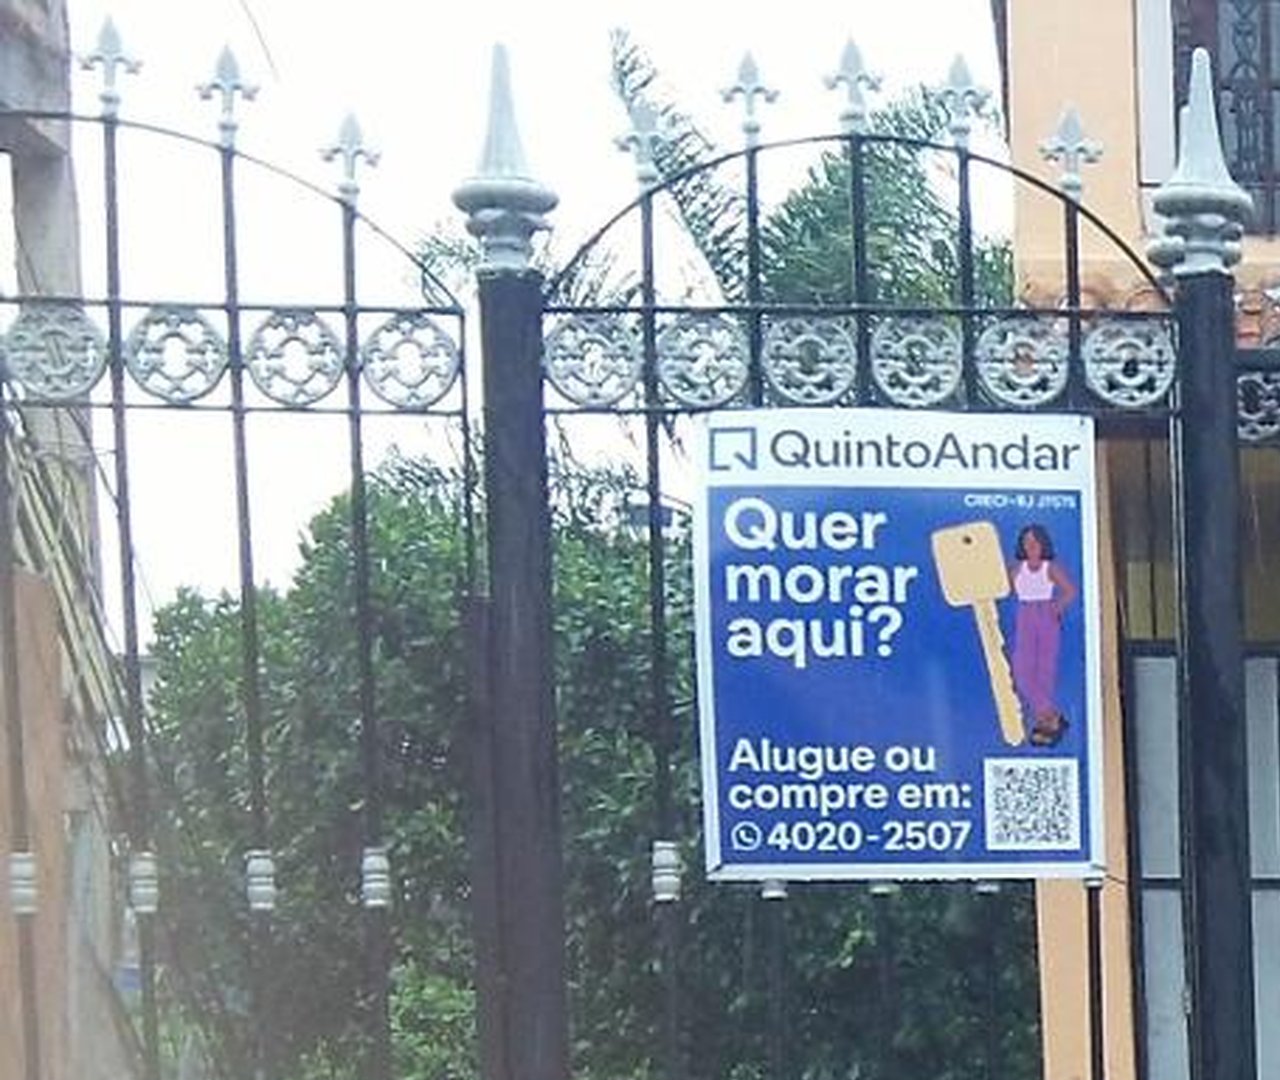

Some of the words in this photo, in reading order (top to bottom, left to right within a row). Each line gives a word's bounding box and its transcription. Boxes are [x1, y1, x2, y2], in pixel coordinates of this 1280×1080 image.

[770, 429, 1080, 471] QuintoAndar
[725, 498, 887, 551] Quer
[726, 564, 917, 603] morar
[727, 605, 902, 668] aqui?
[728, 738, 876, 778] Alugue
[886, 746, 936, 772] ou
[729, 783, 889, 816] compre
[898, 784, 972, 810] em:
[766, 822, 972, 851] 4020-2507
